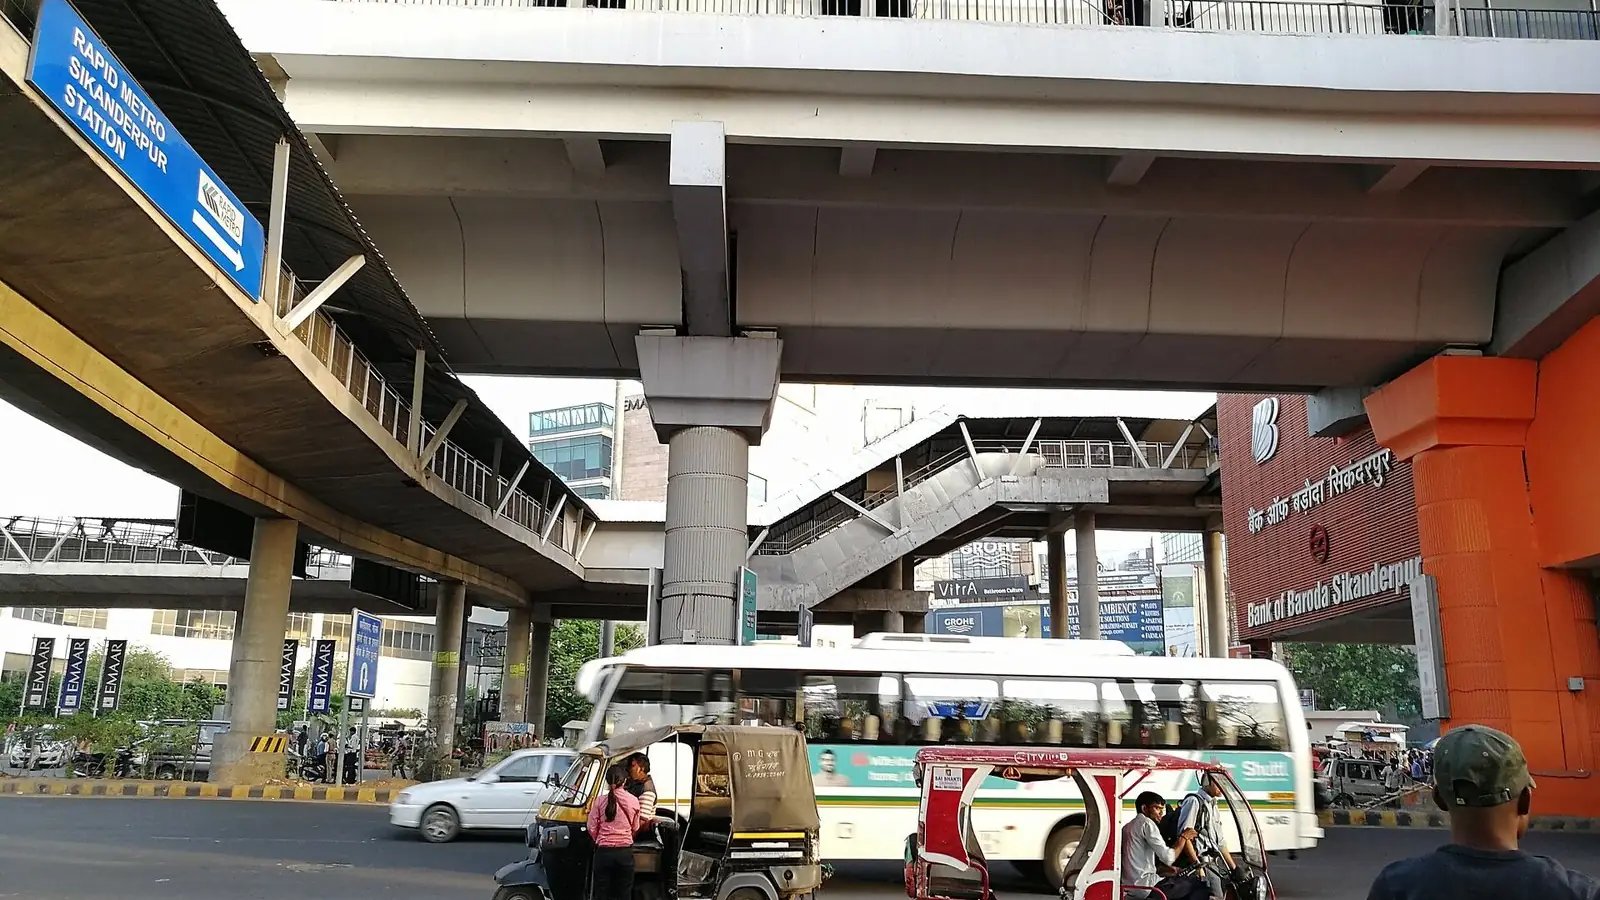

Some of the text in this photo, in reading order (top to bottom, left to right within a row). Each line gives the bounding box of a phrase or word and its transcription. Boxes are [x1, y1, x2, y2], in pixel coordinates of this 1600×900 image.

[73, 26, 167, 142] RAPID METRO
[64, 84, 127, 160] STATION
[68, 55, 168, 174] SIKANDERPUR
[218, 195, 237, 222] RAPID
[220, 212, 241, 238] METRO
[1247, 507, 1264, 534] बैंक
[1328, 447, 1393, 497] सिकंदरपुर
[960, 542, 1021, 554] GROHE
[938, 582, 978, 597] VitrA
[1099, 603, 1137, 615] AMBIENCE
[1247, 556, 1422, 628] Bank of Baroda Sikanderpur
[944, 617, 975, 626] GROHE
[32, 640, 52, 691] EMAAR
[67, 640, 86, 692] EMAAR
[104, 642, 123, 694] EMAAR
[279, 642, 295, 695] EMAAR
[314, 643, 332, 696] EMAAR
